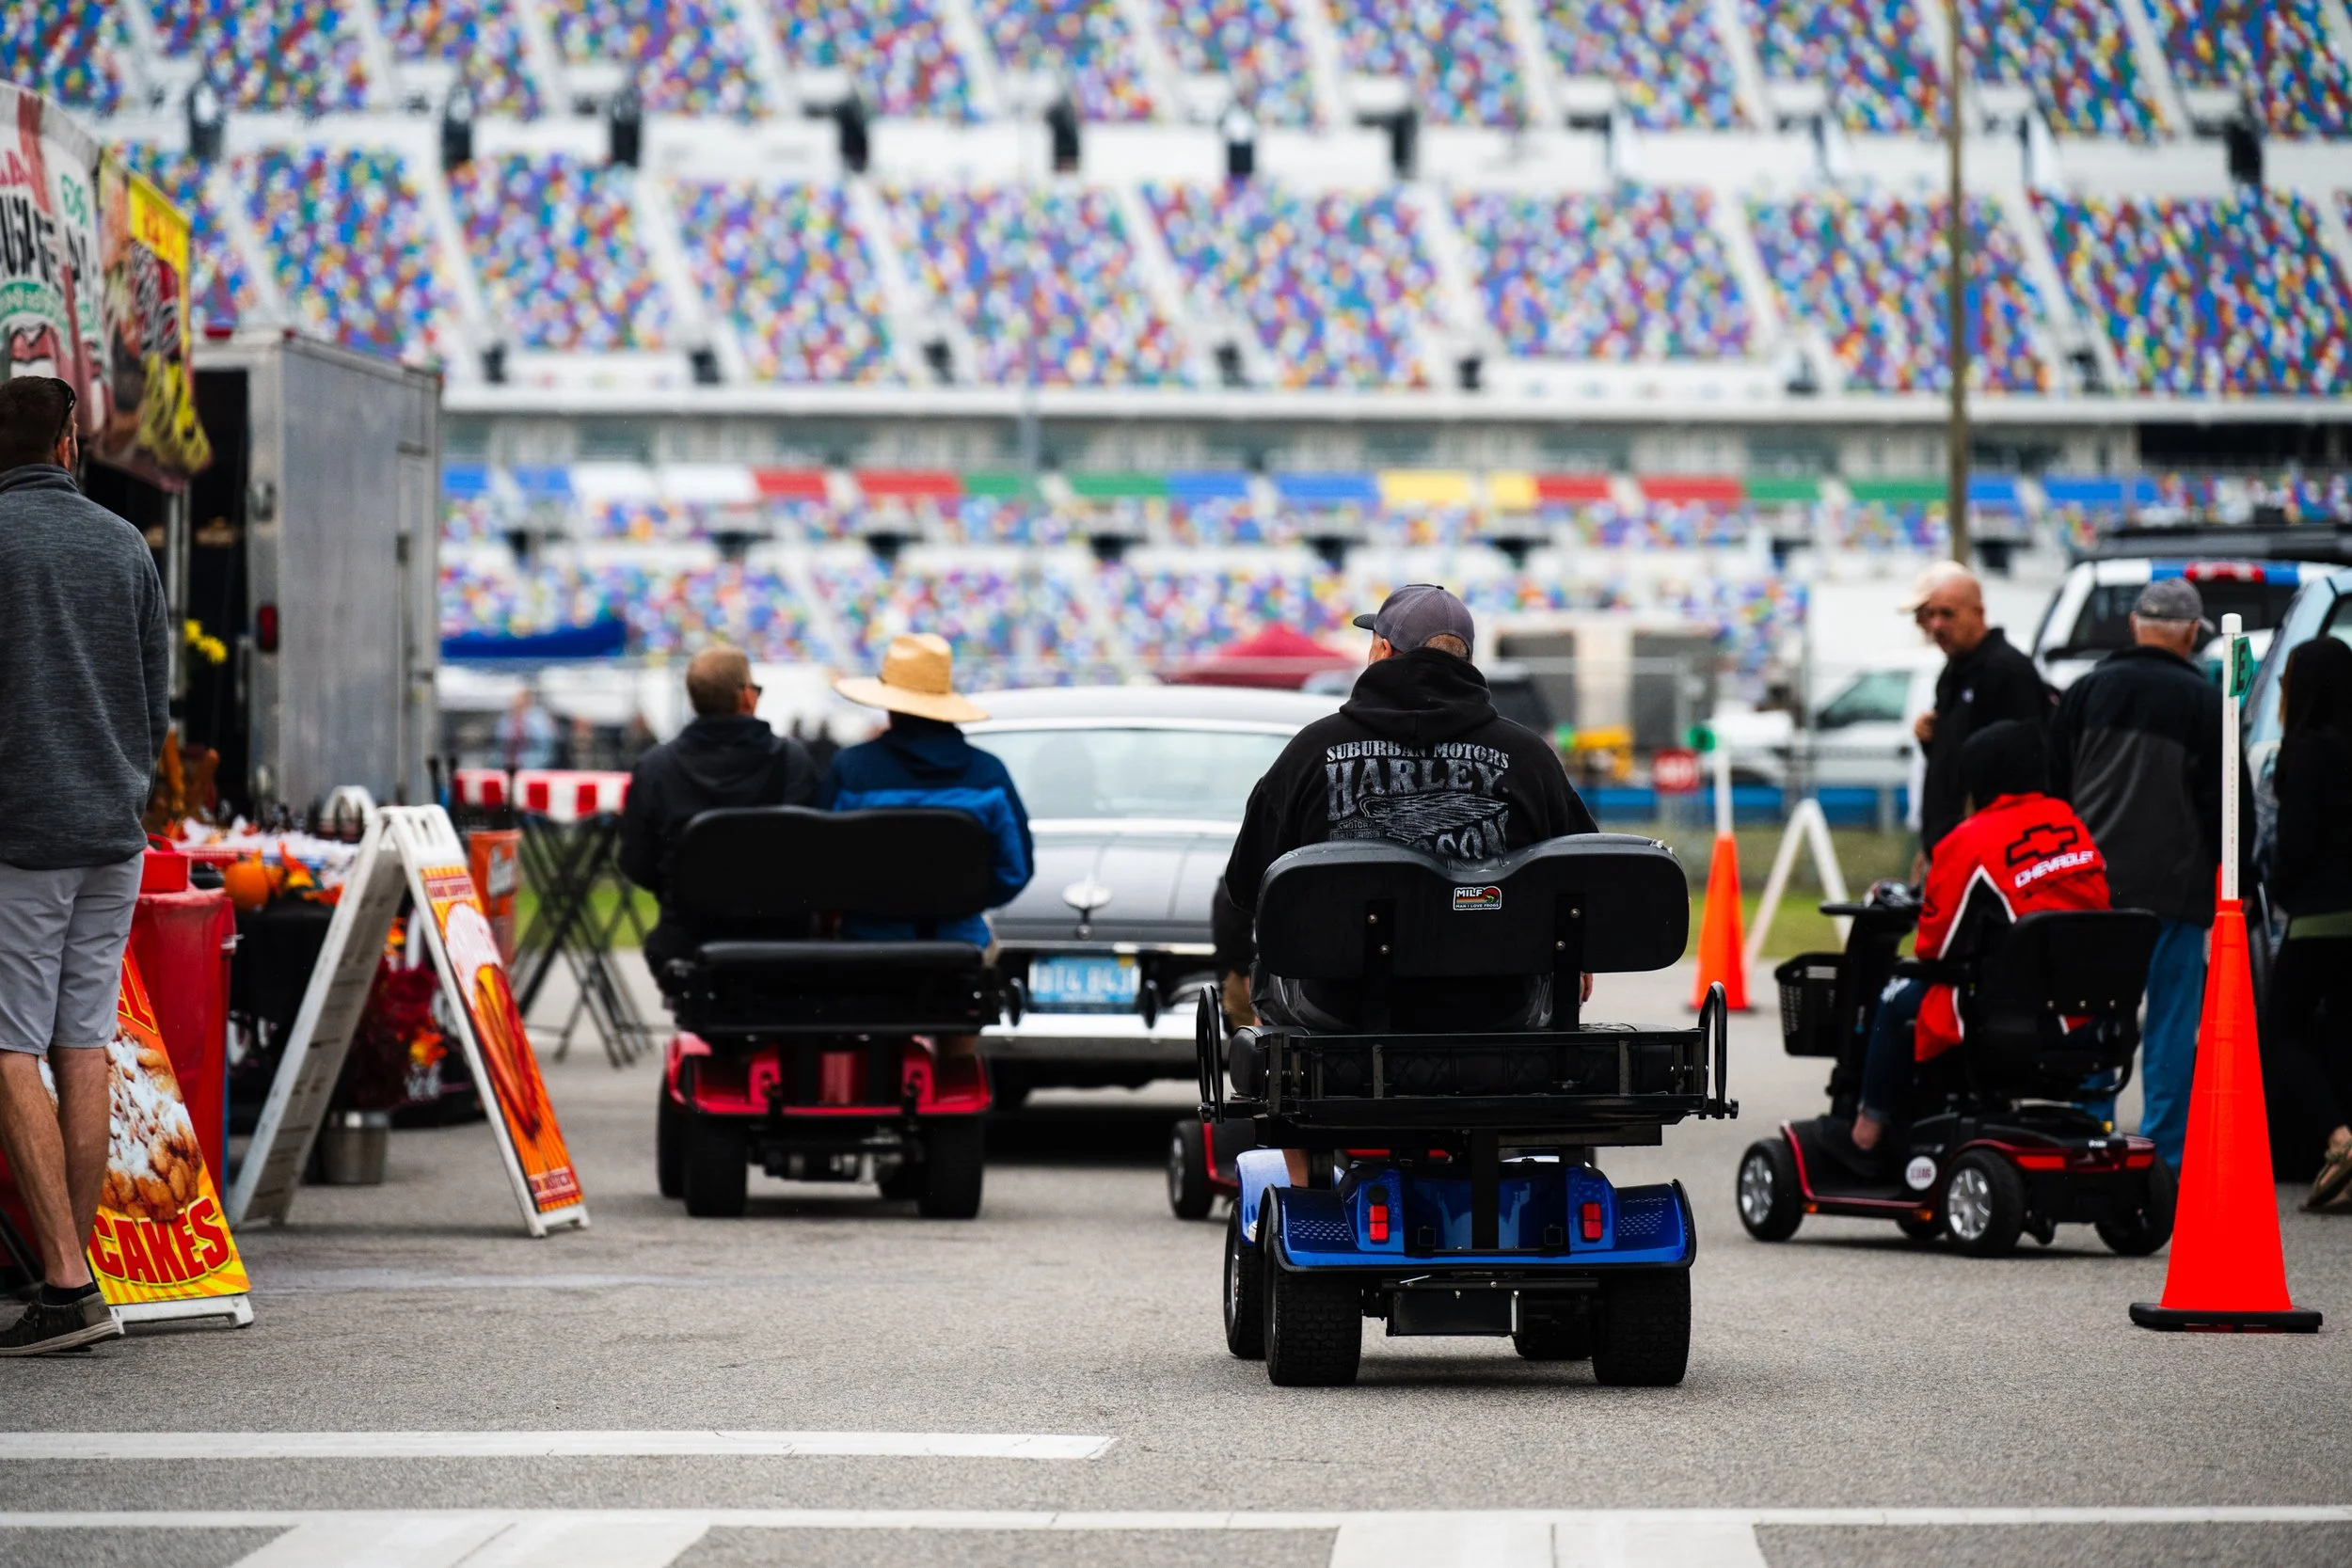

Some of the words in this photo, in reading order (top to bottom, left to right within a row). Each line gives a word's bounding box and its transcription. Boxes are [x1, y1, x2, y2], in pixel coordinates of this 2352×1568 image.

[1327, 739, 1426, 762] SUBURBAN
[1433, 742, 1509, 769] MOTORS
[1343, 819, 1369, 830] MOTOR
[1456, 889, 1483, 897] MILF
[88, 1196, 230, 1286] CAKES
